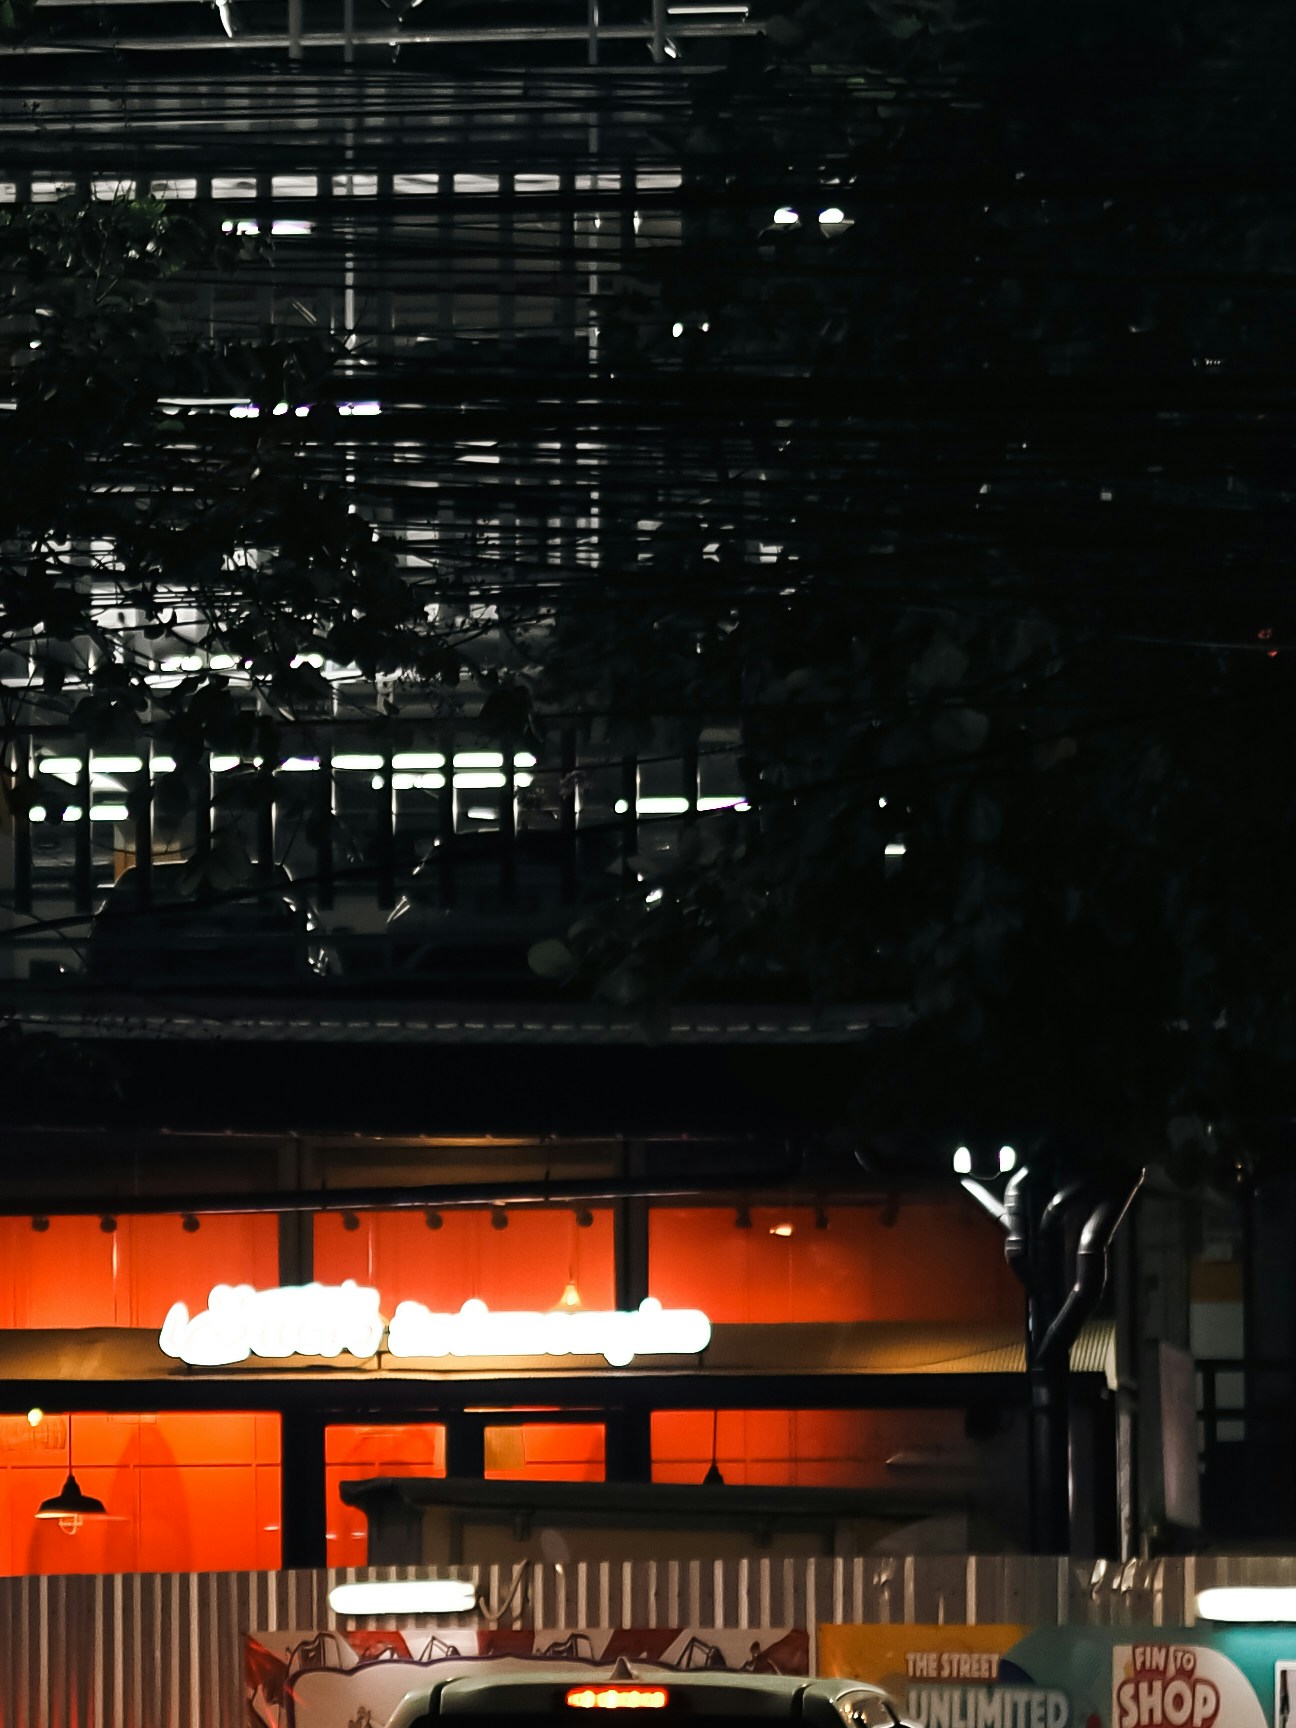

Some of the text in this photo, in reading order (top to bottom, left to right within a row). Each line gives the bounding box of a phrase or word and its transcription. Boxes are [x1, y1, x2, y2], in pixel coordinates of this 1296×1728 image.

[906, 1652, 1000, 1679] THE STREET
[1133, 1645, 1196, 1672] FIN TO
